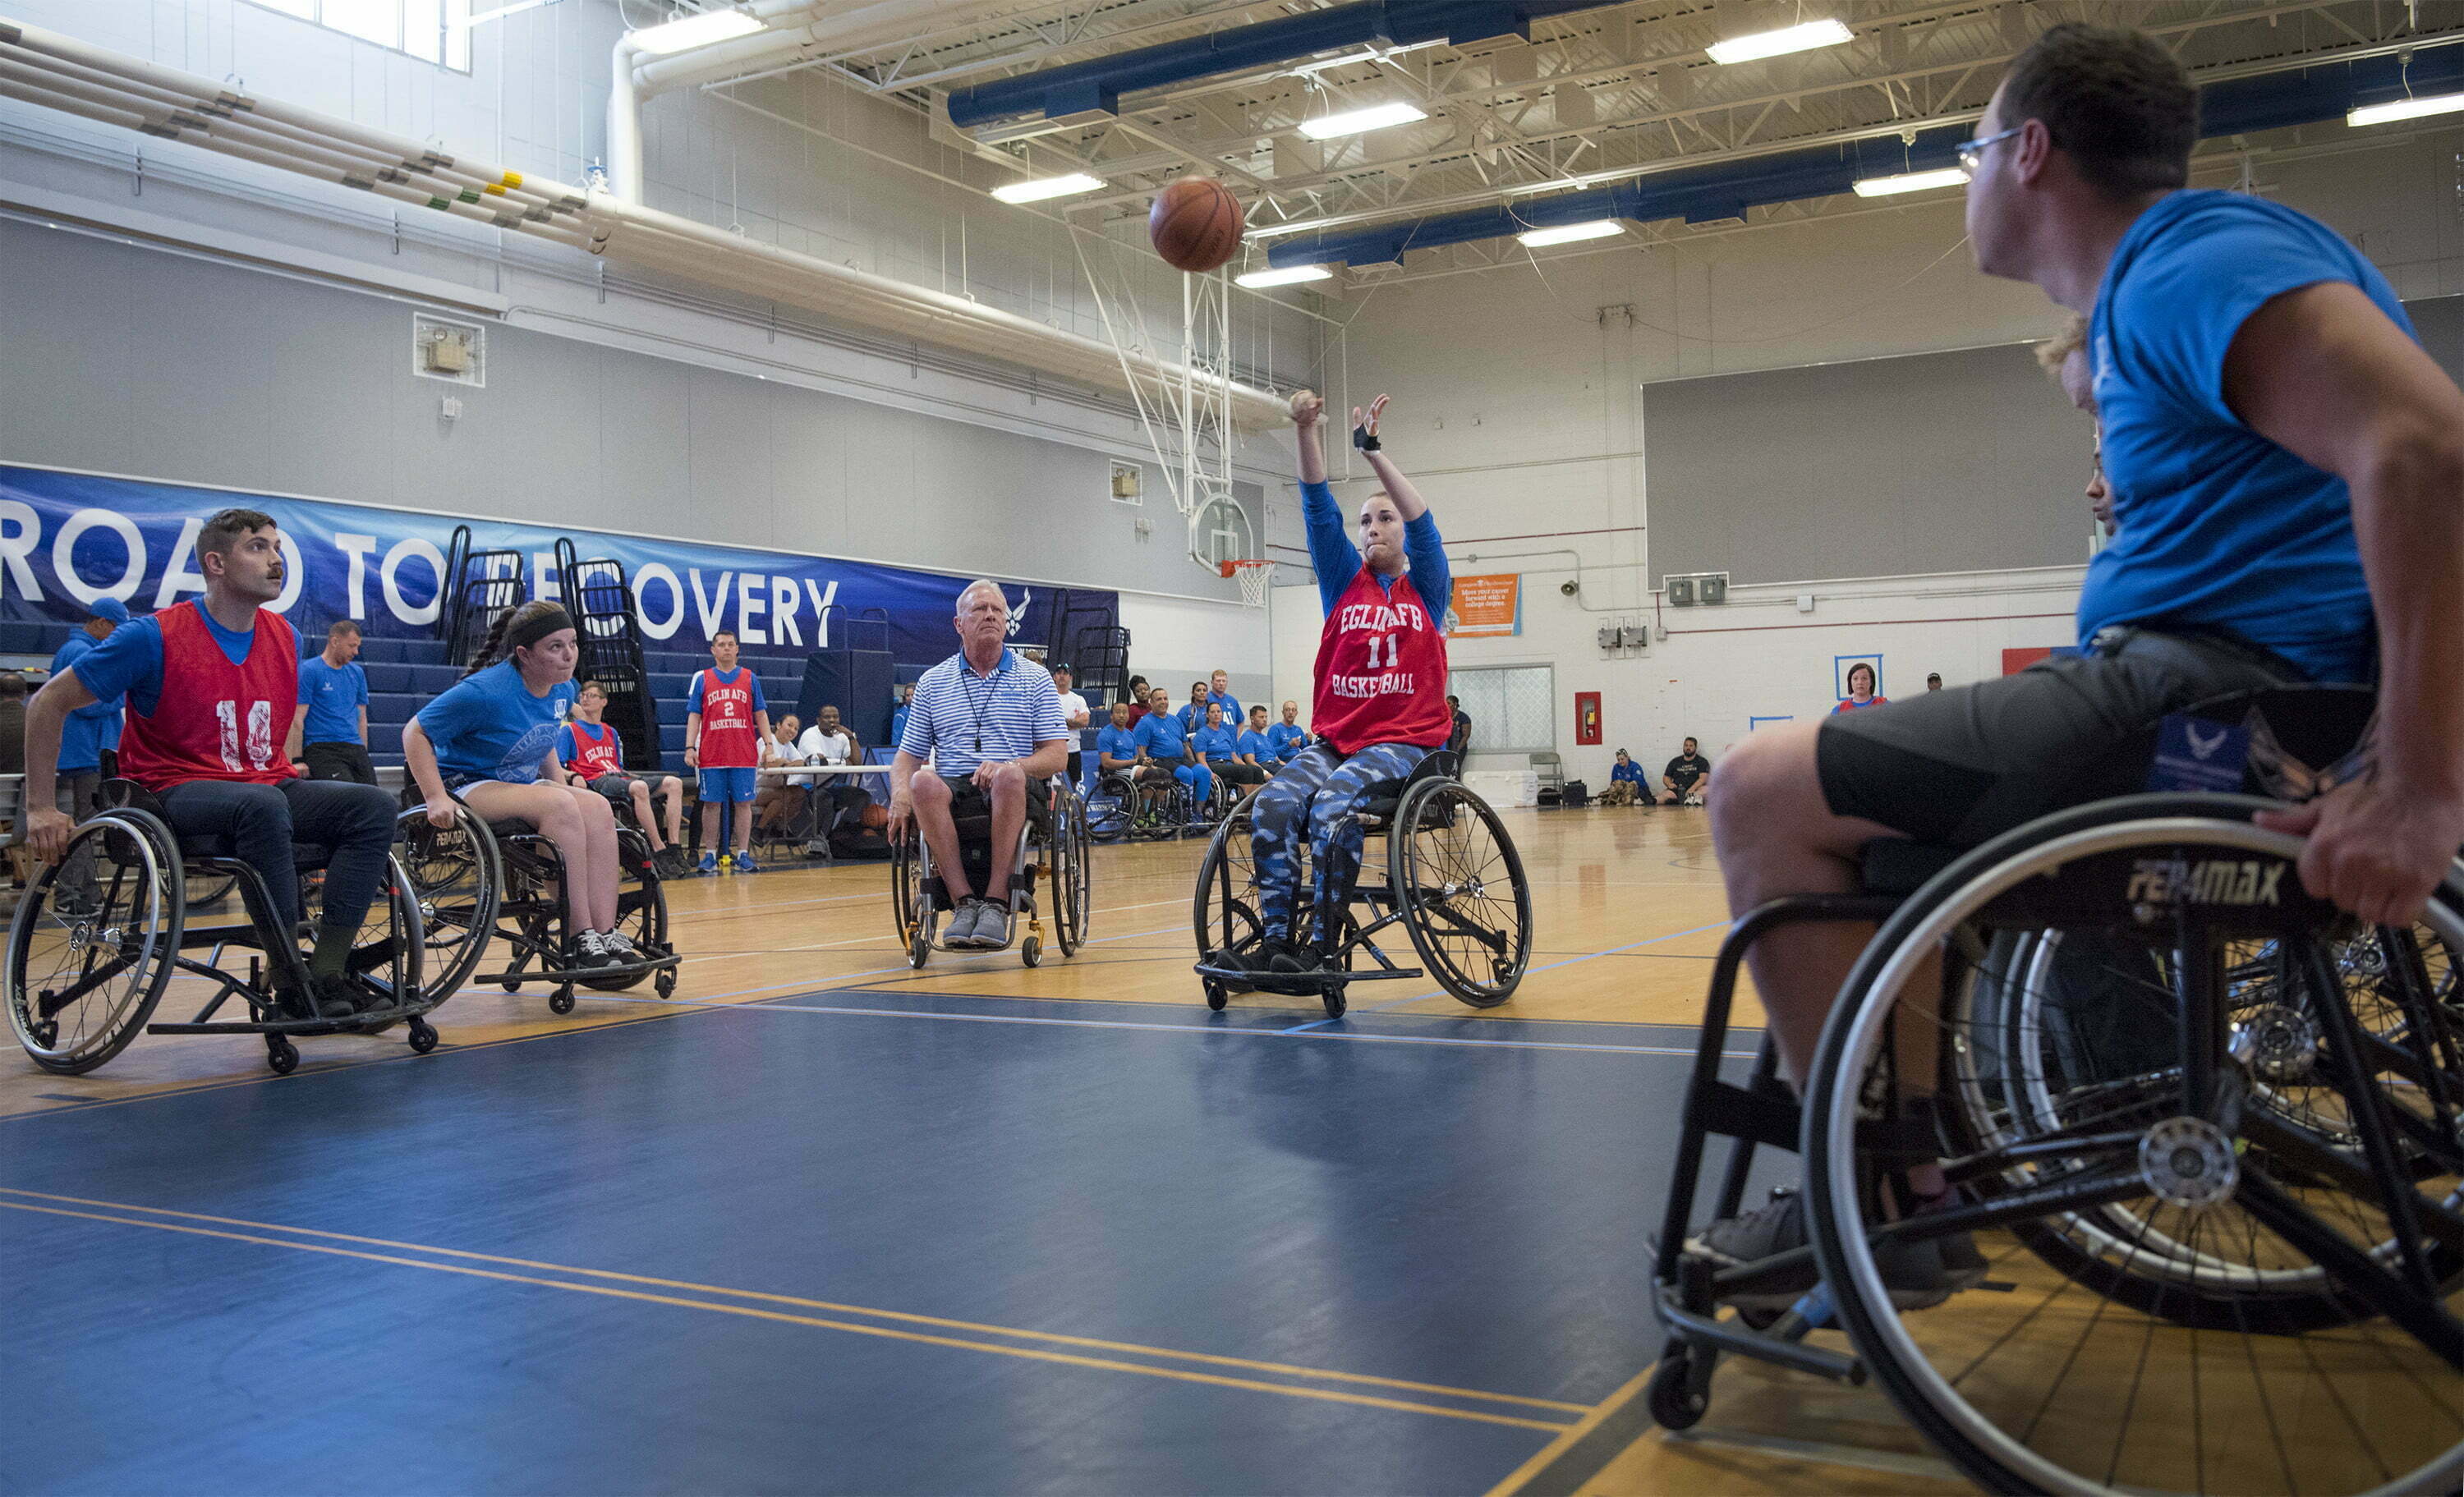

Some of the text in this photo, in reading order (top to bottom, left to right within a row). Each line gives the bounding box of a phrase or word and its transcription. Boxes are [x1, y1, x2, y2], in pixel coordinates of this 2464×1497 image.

[334, 532, 452, 626] TO
[1387, 603, 1423, 632] AFB
[1367, 633, 1398, 669] 11
[707, 688, 747, 706] EGLIN AFB
[724, 701, 734, 717] 2
[710, 718, 747, 731] BASKETBALL
